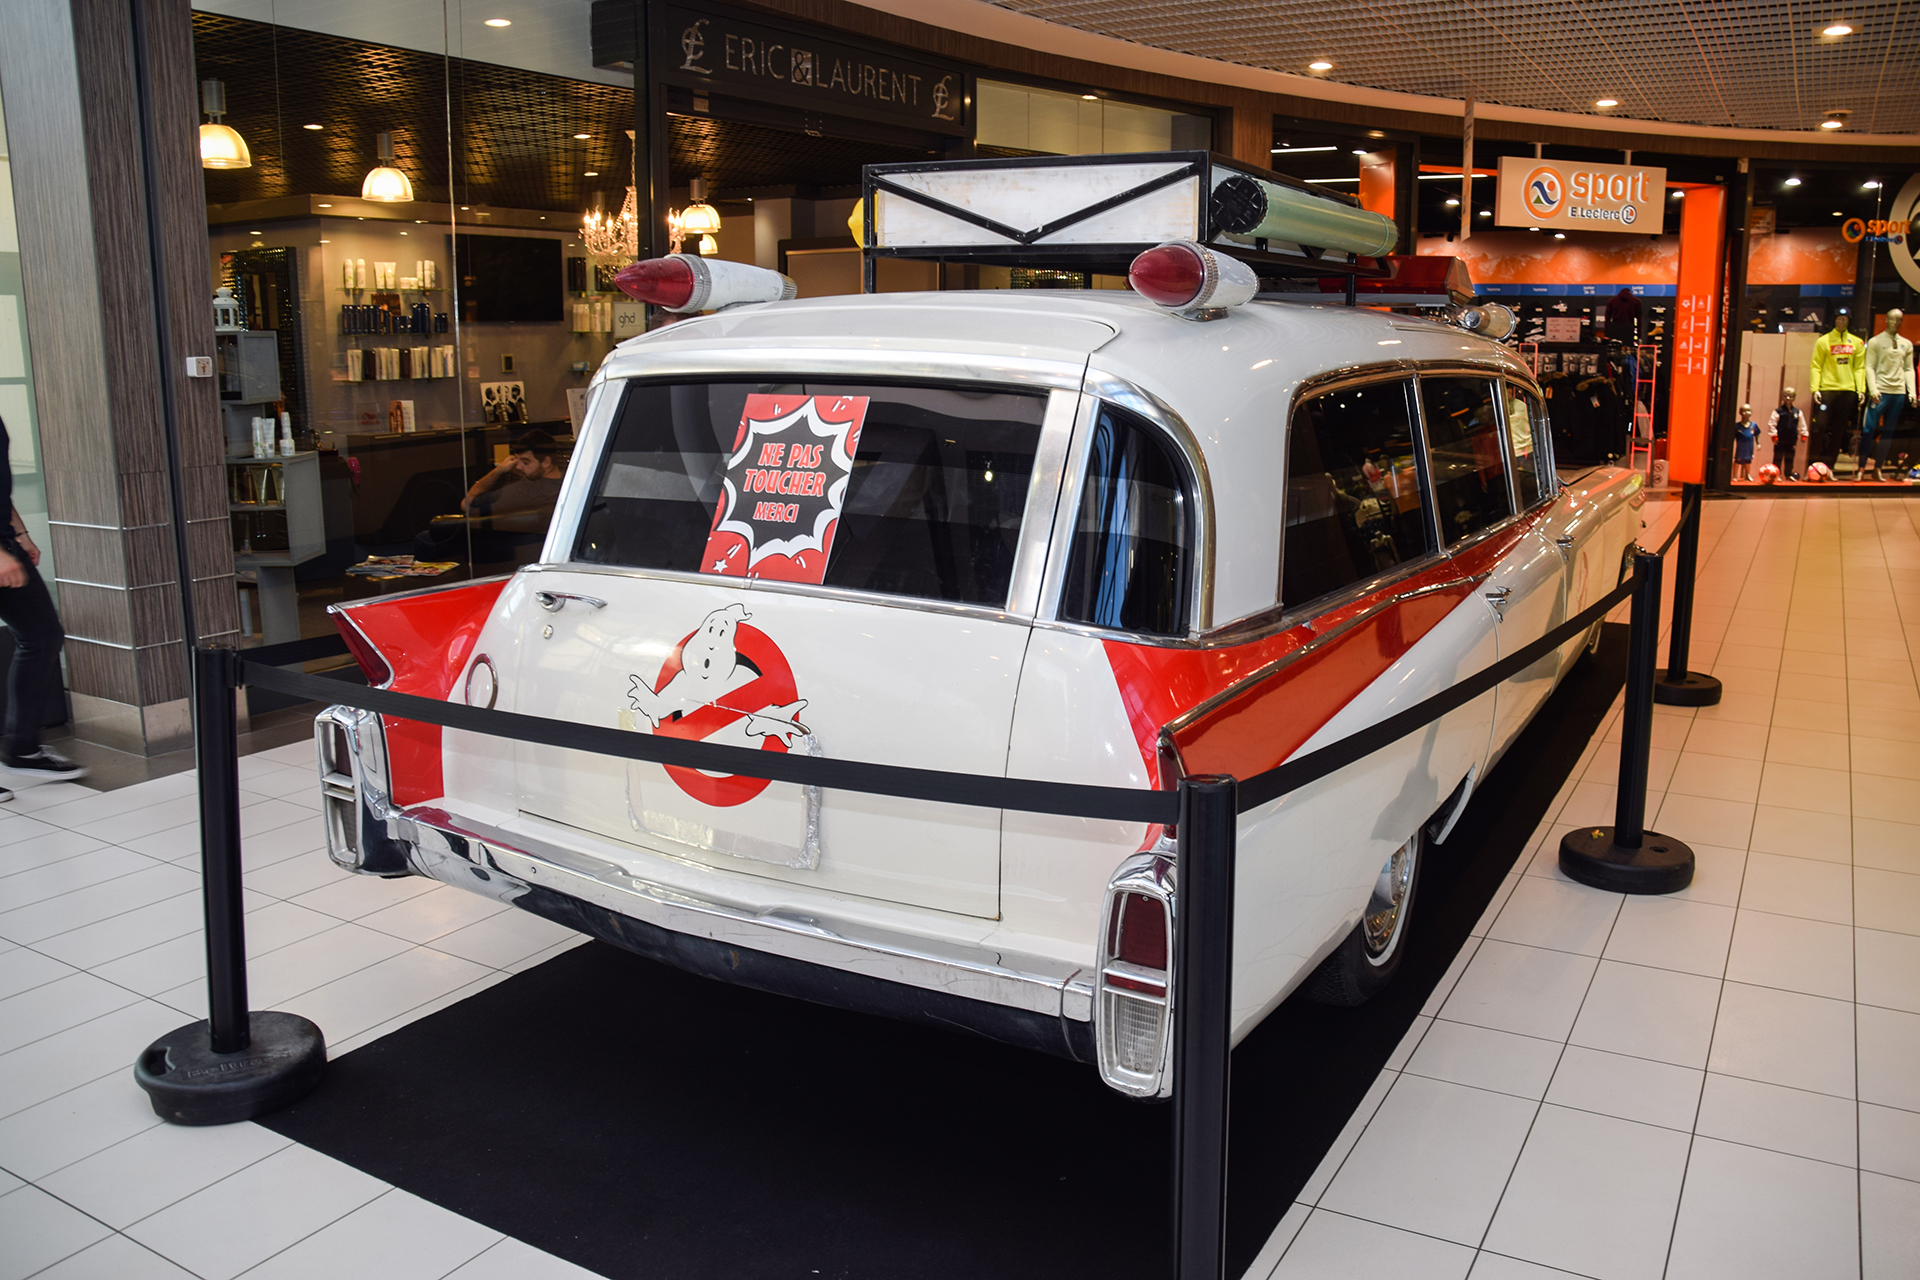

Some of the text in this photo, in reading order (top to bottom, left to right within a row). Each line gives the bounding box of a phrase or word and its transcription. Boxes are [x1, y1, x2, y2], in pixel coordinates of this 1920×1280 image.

[725, 33, 785, 80] ERIC
[815, 53, 922, 106] LAURENT
[1570, 171, 1650, 206] sport
[1569, 206, 1620, 220] E.Leclerc
[1867, 219, 1912, 236] sport
[618, 312, 636, 328] ghd
[758, 443, 824, 469] NE PAS
[743, 469, 827, 498] TOUCHER
[752, 501, 800, 524] MERCI
